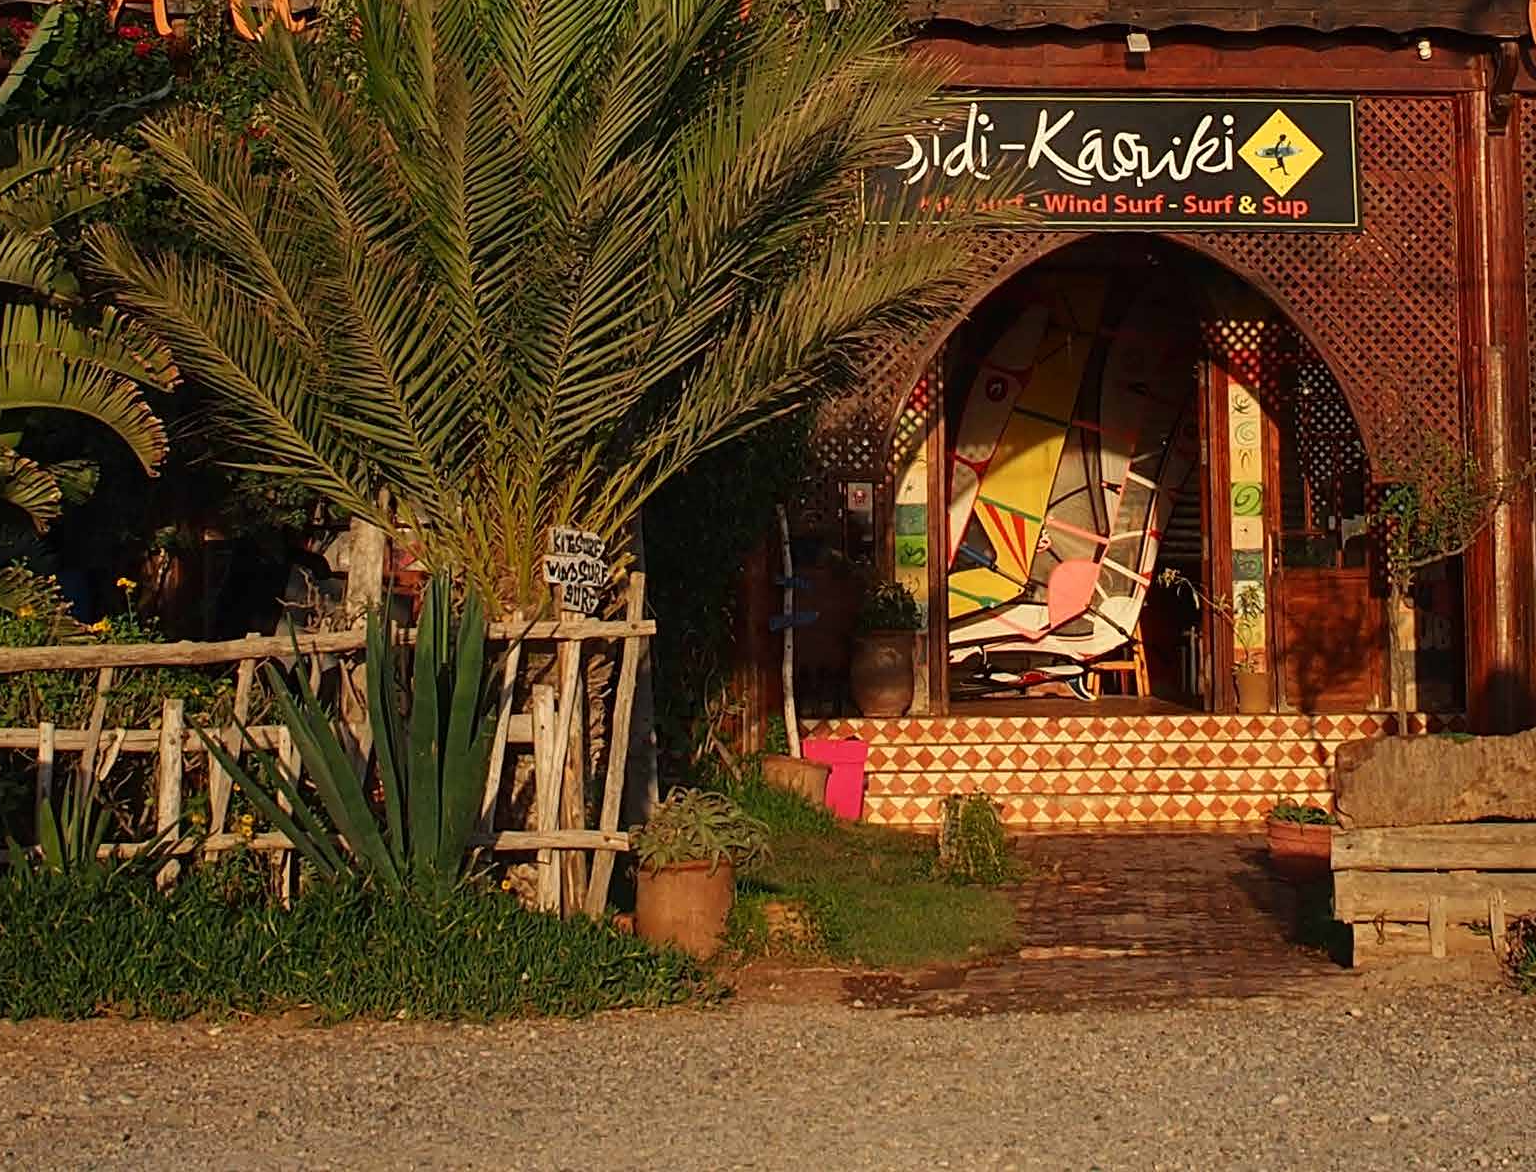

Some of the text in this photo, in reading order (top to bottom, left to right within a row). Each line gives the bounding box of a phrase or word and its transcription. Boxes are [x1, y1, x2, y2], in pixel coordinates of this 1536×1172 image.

[1044, 193, 1107, 214] Wind
[1114, 193, 1164, 214] Surf
[1183, 195, 1234, 215] Surf
[1238, 195, 1257, 215] &
[1262, 196, 1309, 219] Sup
[564, 584, 597, 612] SURF
